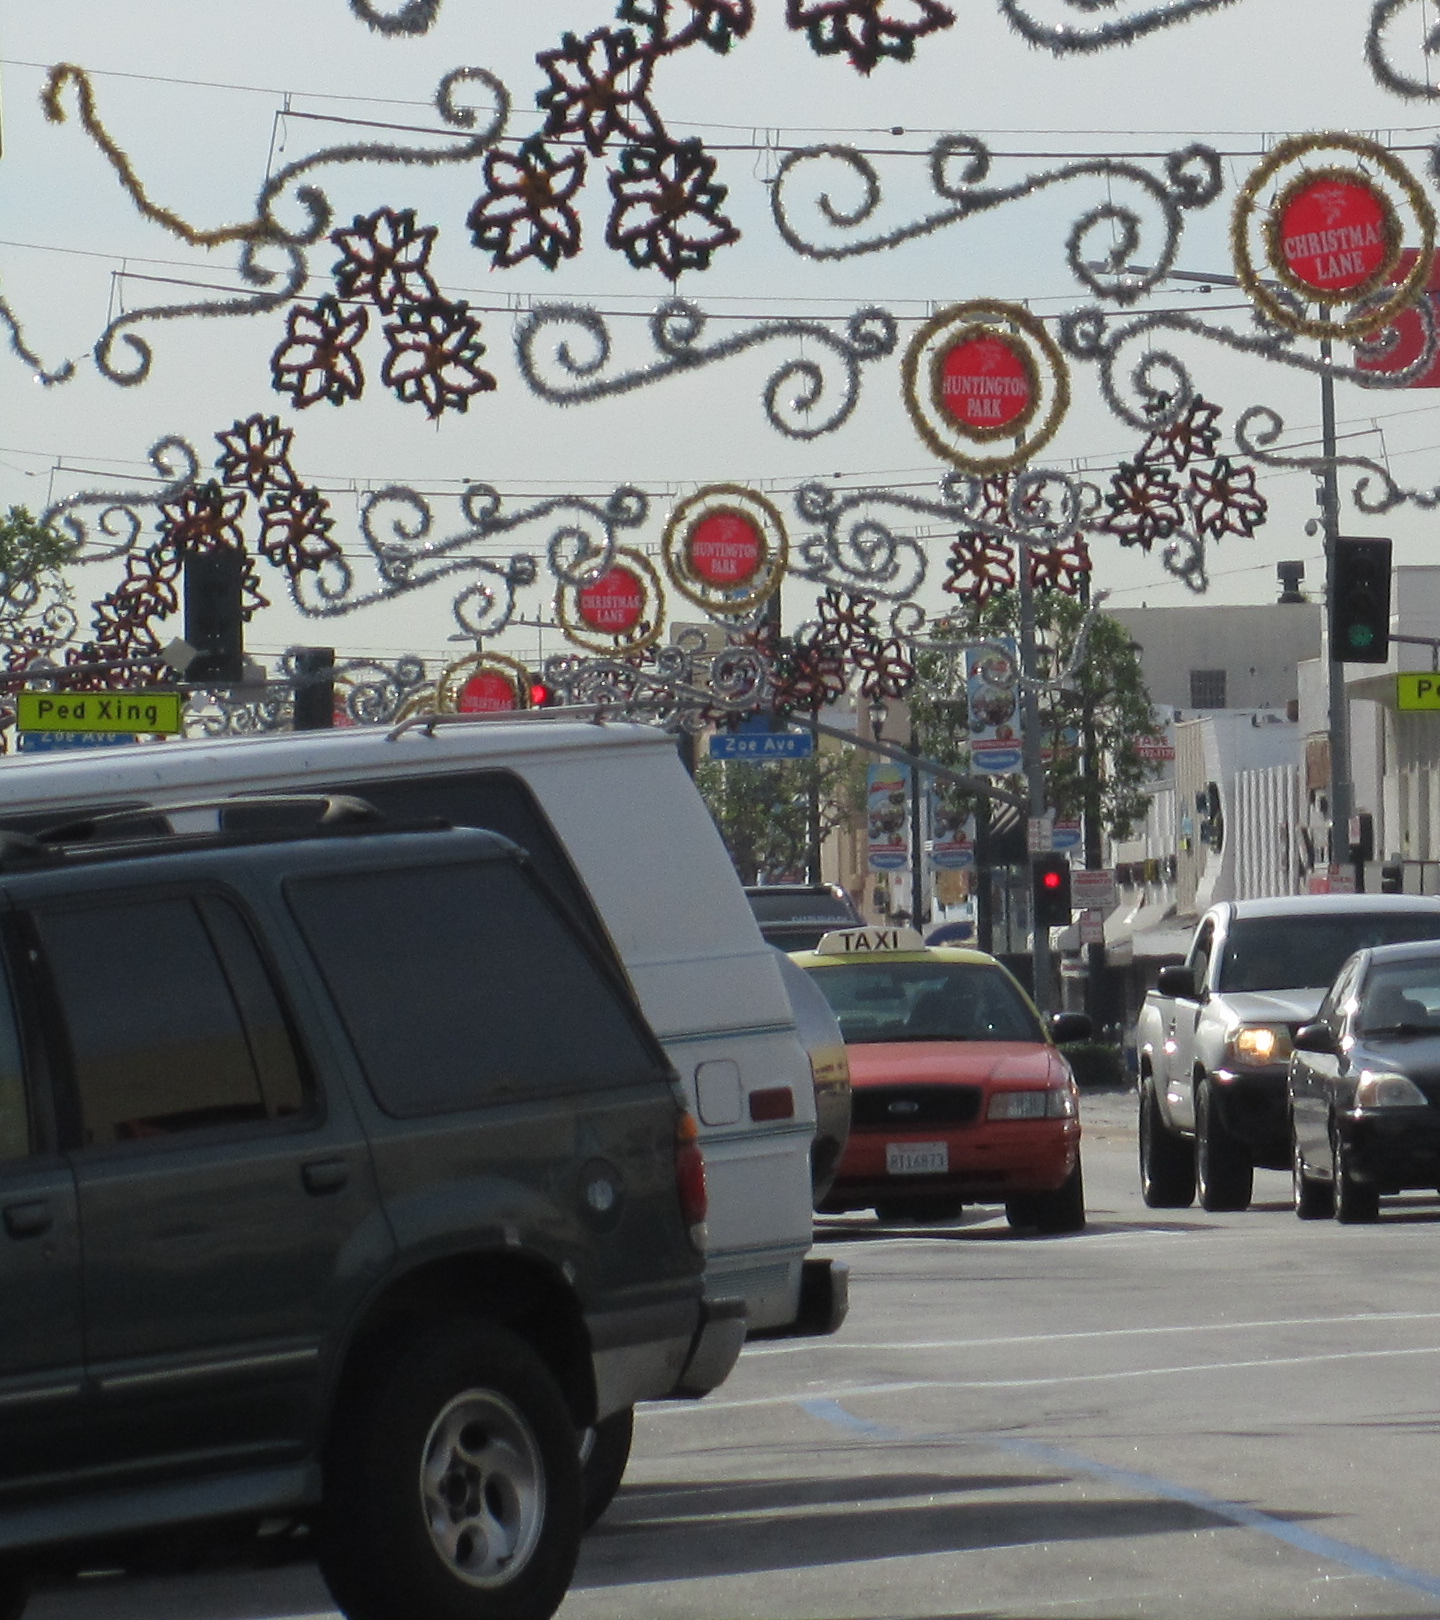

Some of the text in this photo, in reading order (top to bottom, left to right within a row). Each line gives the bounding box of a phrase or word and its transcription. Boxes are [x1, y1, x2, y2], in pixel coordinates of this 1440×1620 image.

[1314, 250, 1365, 280] LANE
[967, 398, 1002, 418] PARK
[37, 699, 158, 726] Ped Xing
[725, 737, 795, 751] Zoe Ave
[839, 930, 898, 952] TAXI
